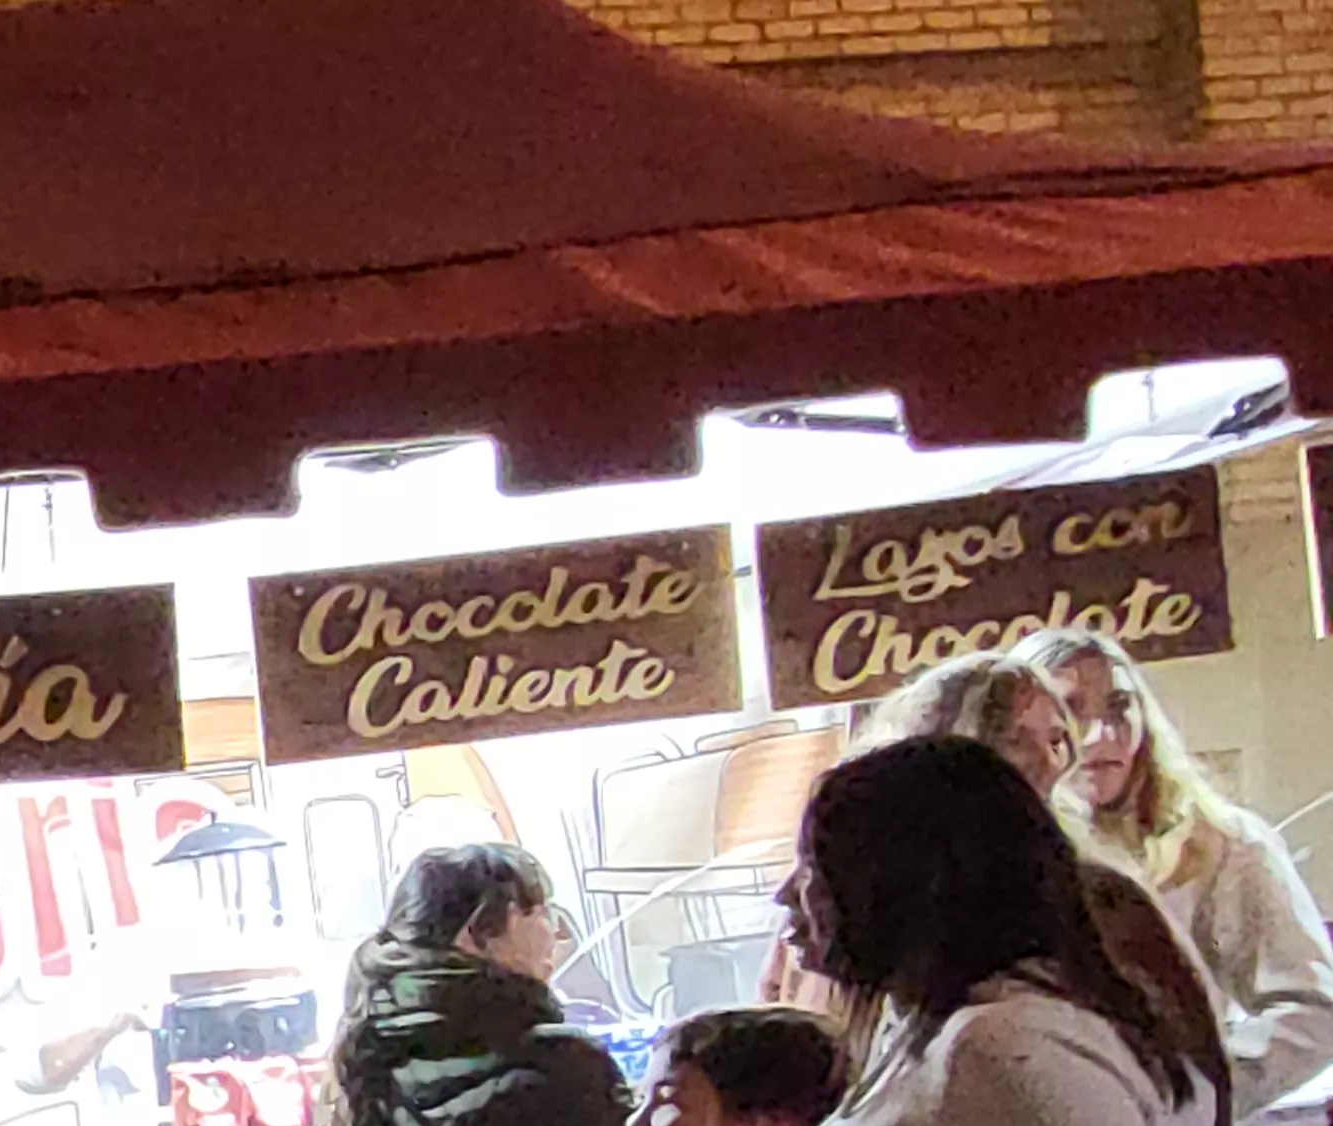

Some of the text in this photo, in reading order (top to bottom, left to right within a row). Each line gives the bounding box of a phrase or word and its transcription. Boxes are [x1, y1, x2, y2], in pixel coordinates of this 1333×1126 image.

[813, 501, 1195, 603] Lazos con
[297, 554, 703, 665] Chocolate
[346, 639, 676, 739] Caliente
